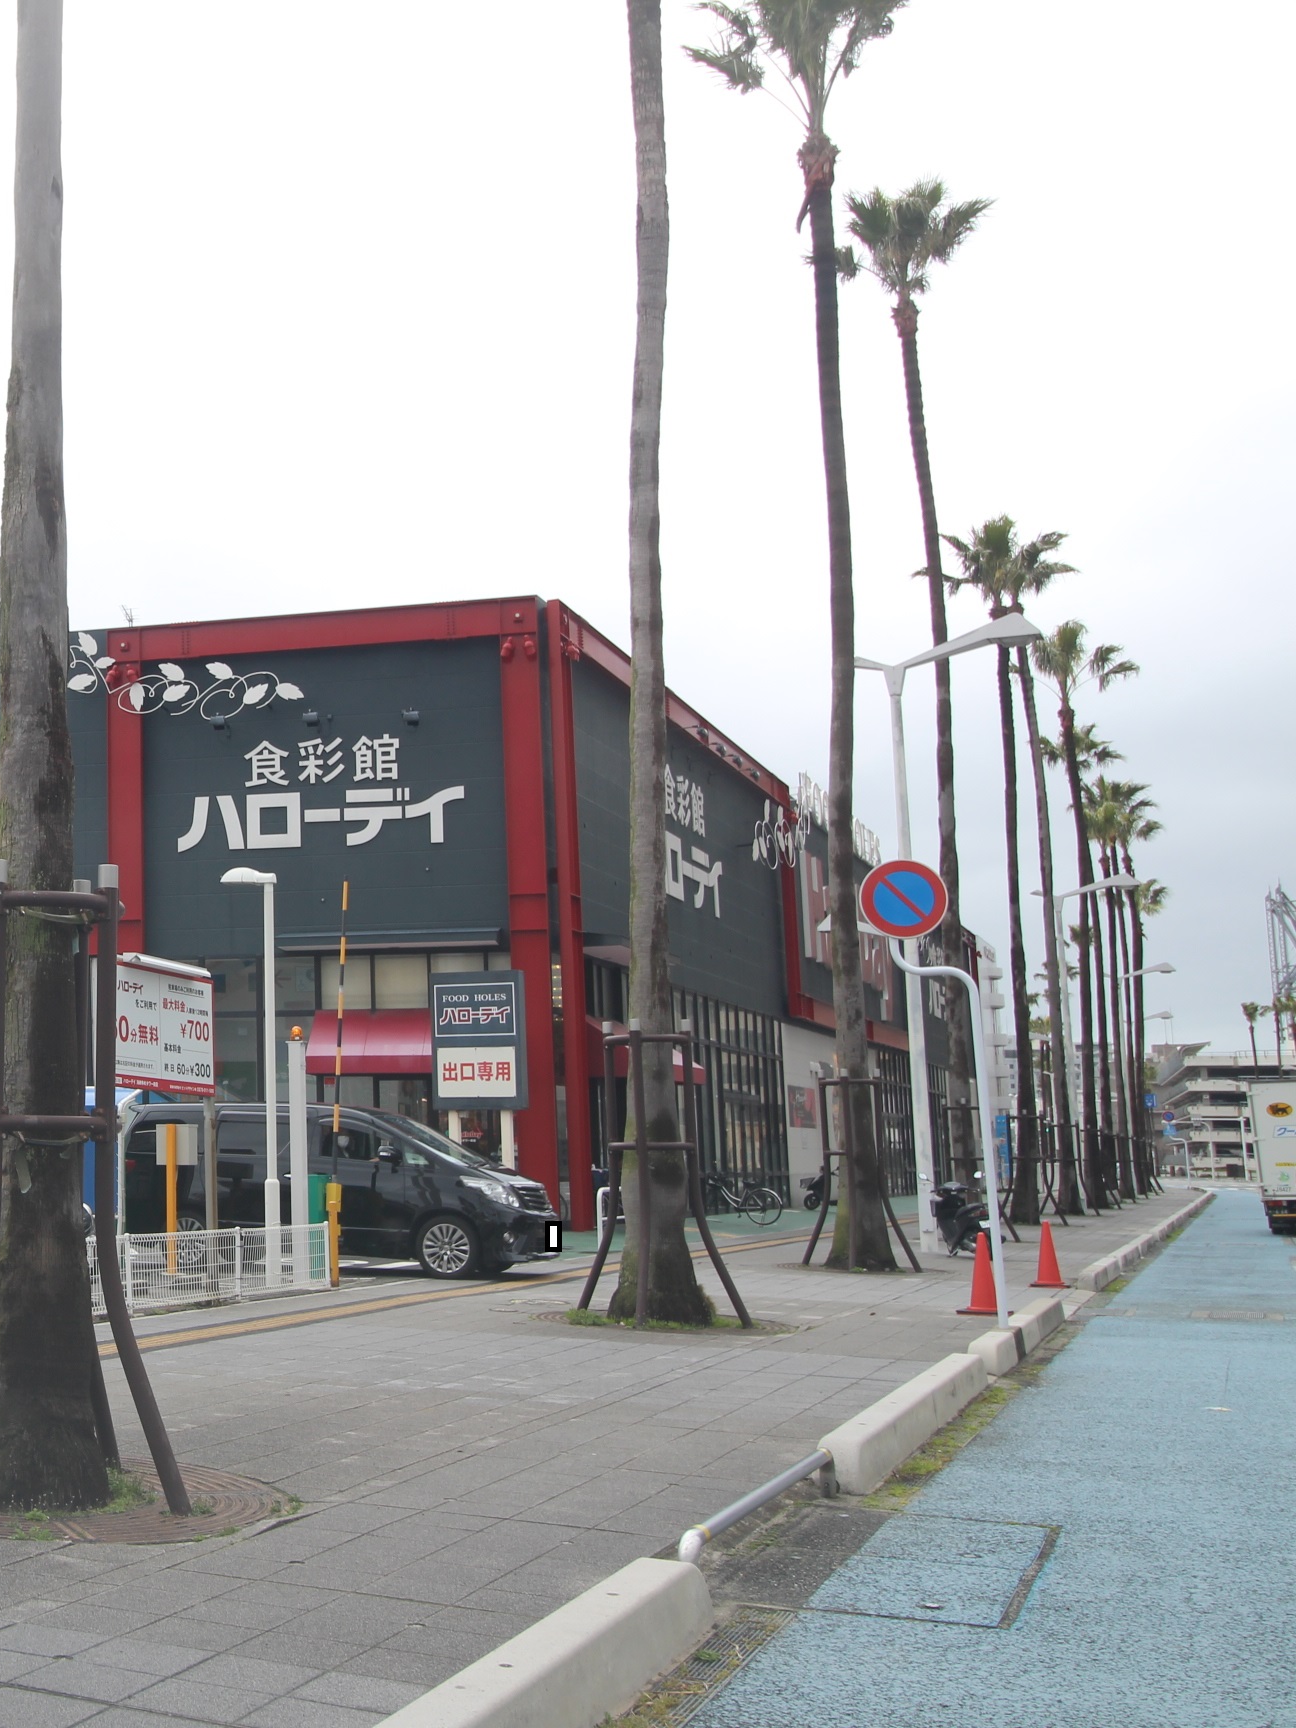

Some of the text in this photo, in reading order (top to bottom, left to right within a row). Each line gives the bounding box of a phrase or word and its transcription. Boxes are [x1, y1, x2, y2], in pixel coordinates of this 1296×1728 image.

[243, 733, 400, 787] 食彩館
[664, 763, 706, 838] 食彩館
[177, 785, 466, 853] ハローデイ
[665, 830, 722, 919] ローデイ
[442, 993, 507, 1003] FOOD HOLES
[439, 1006, 511, 1026] ハローデイ
[115, 1015, 159, 1046] 0分無料
[180, 1019, 210, 1042] ¥700
[442, 1061, 511, 1082] 出口専用
[1276, 1127, 1296, 1137] クー
